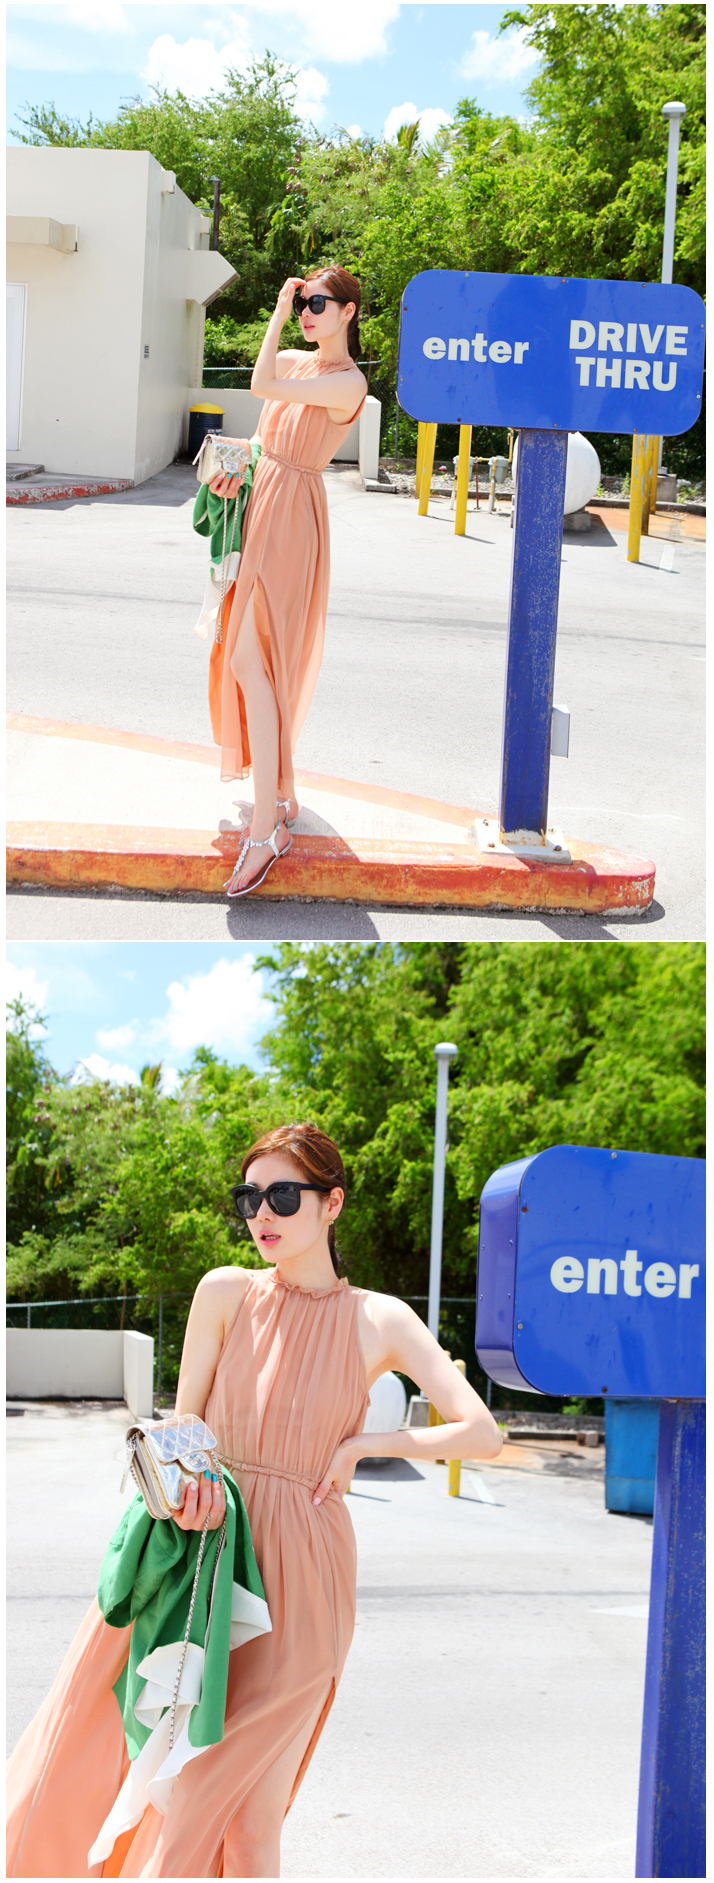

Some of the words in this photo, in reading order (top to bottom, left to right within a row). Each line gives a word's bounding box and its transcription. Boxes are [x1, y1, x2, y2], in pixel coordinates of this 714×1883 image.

[423, 333, 530, 364] enter
[569, 320, 688, 355] DRIVE
[575, 357, 678, 391] THRU
[550, 1250, 700, 1298] enter
